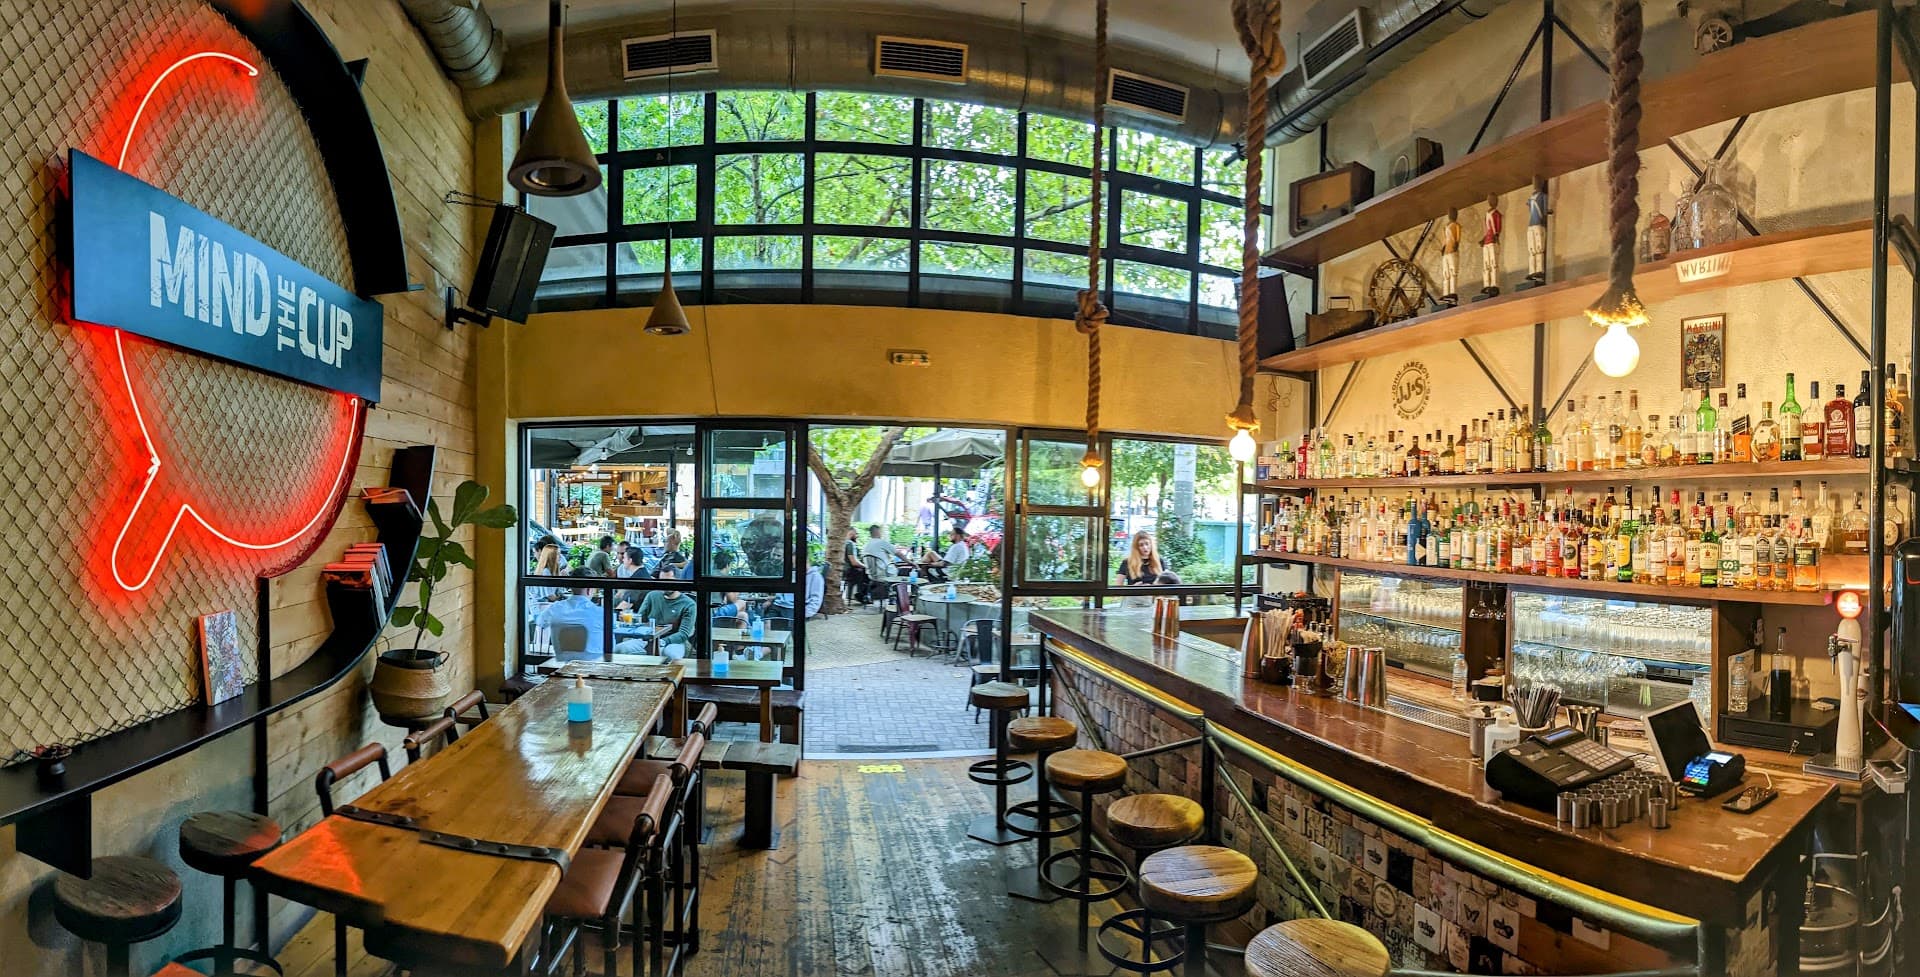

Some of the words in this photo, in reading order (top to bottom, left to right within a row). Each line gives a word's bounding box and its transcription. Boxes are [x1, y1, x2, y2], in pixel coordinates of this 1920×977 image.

[149, 211, 271, 337] MIND
[277, 275, 296, 351] THE
[299, 286, 353, 368] CUP
[1686, 320, 1721, 334] MARTINI
